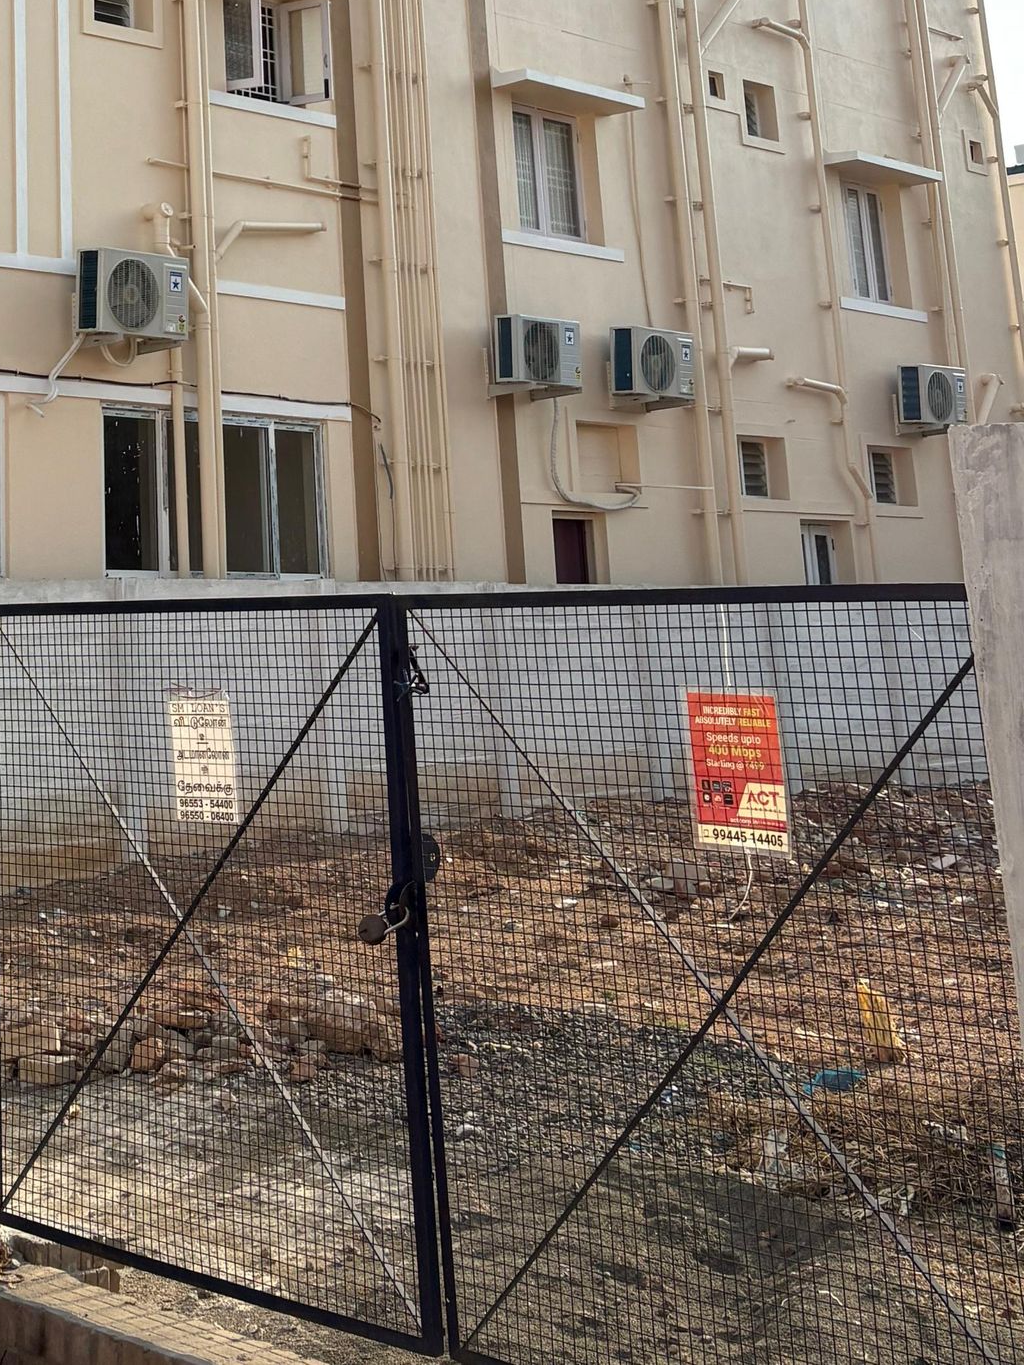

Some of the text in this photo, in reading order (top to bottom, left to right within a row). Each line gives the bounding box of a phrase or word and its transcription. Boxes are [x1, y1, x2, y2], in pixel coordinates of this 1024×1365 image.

[743, 708, 760, 717] FAST
[706, 732, 738, 743] Speeds
[708, 745, 761, 760] 400 Mbps
[706, 758, 735, 770] Starting
[210, 800, 233, 809] 54400
[746, 790, 779, 807] ACT
[712, 828, 783, 847] 99445 14405
